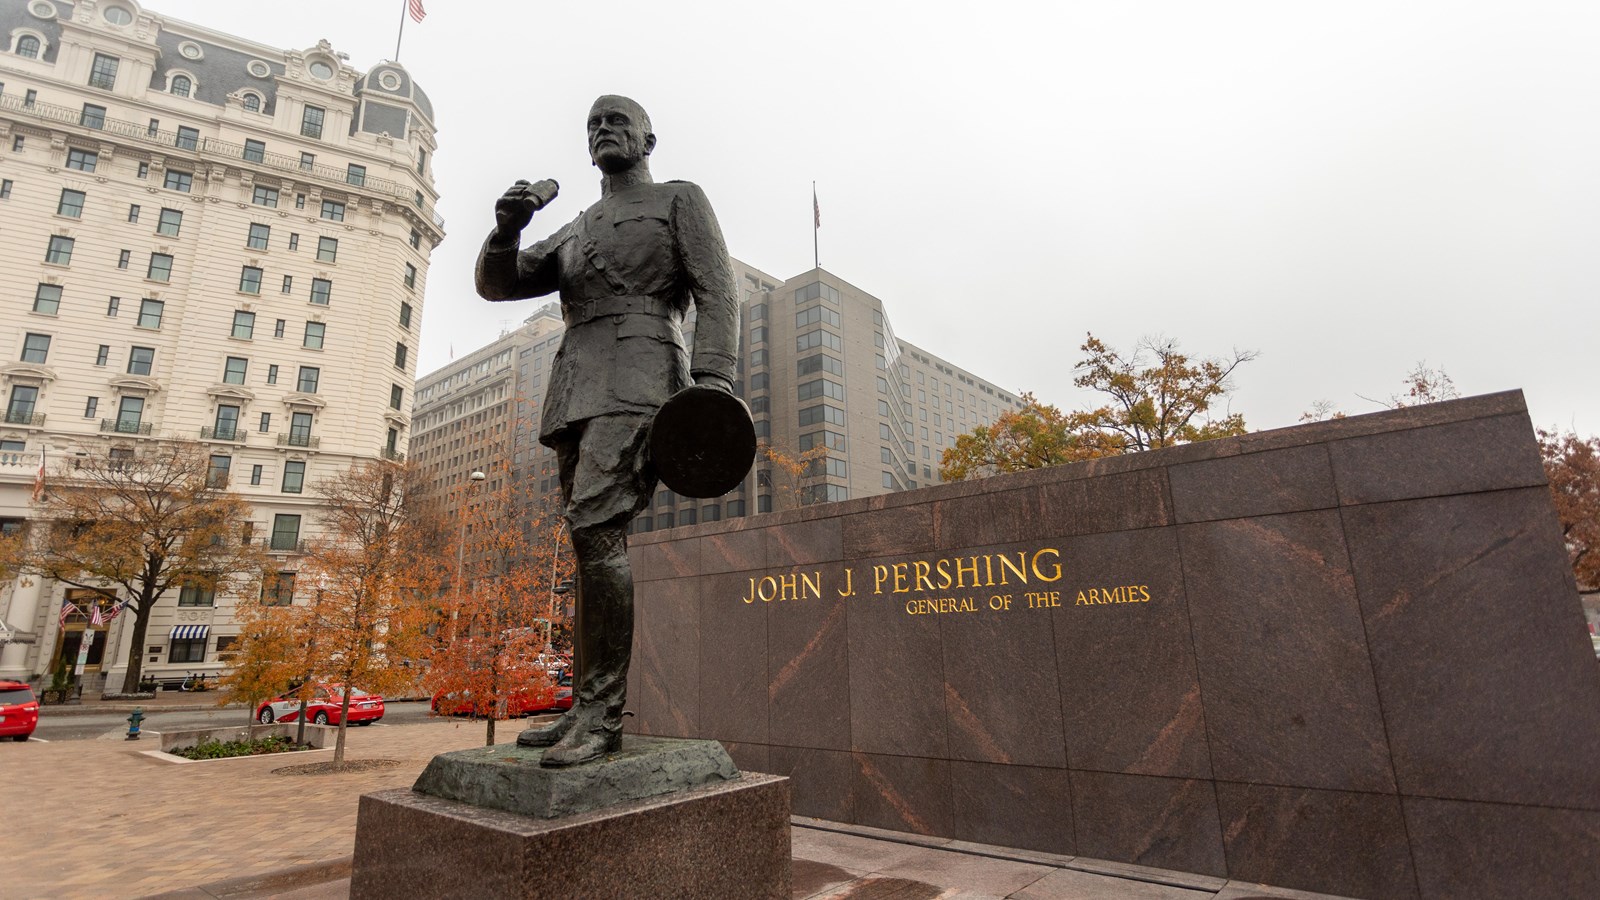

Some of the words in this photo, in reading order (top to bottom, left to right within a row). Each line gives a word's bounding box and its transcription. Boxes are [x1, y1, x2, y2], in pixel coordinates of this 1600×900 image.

[743, 570, 822, 604] JOHN
[838, 569, 857, 598] J.
[874, 548, 1063, 595] PERSHING
[906, 596, 979, 615] GENERAL
[988, 594, 1012, 611] OF
[1024, 591, 1061, 609] THE
[1075, 585, 1151, 606] ARMIES
